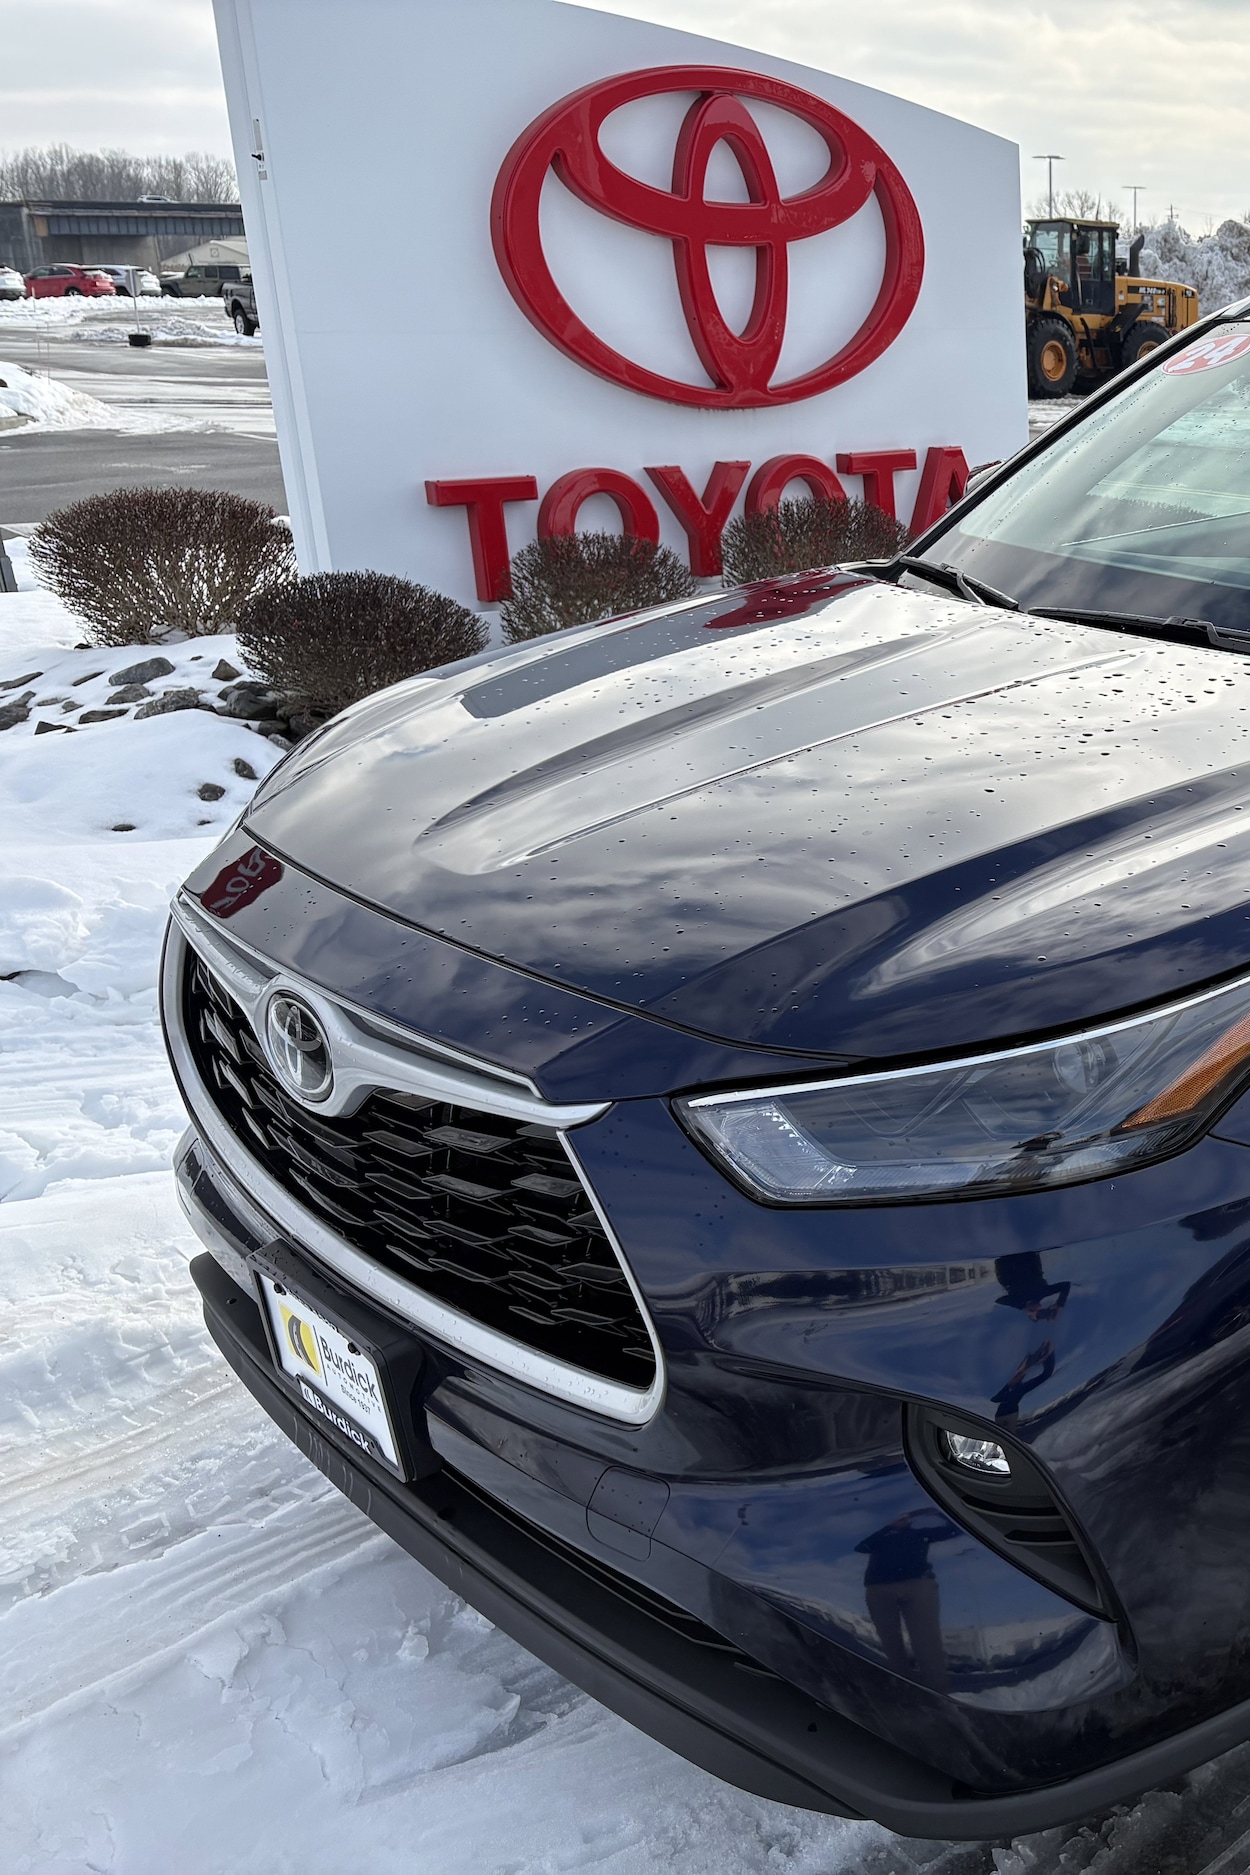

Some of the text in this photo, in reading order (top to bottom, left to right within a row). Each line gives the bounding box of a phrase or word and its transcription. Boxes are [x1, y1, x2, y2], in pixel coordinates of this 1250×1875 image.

[1167, 335, 1250, 373] 24
[320, 1334, 380, 1403] Burdick
[326, 1364, 383, 1413] AUTOMOTIVE
[340, 1384, 372, 1416] Since 1937
[314, 1395, 373, 1455] Burdick
